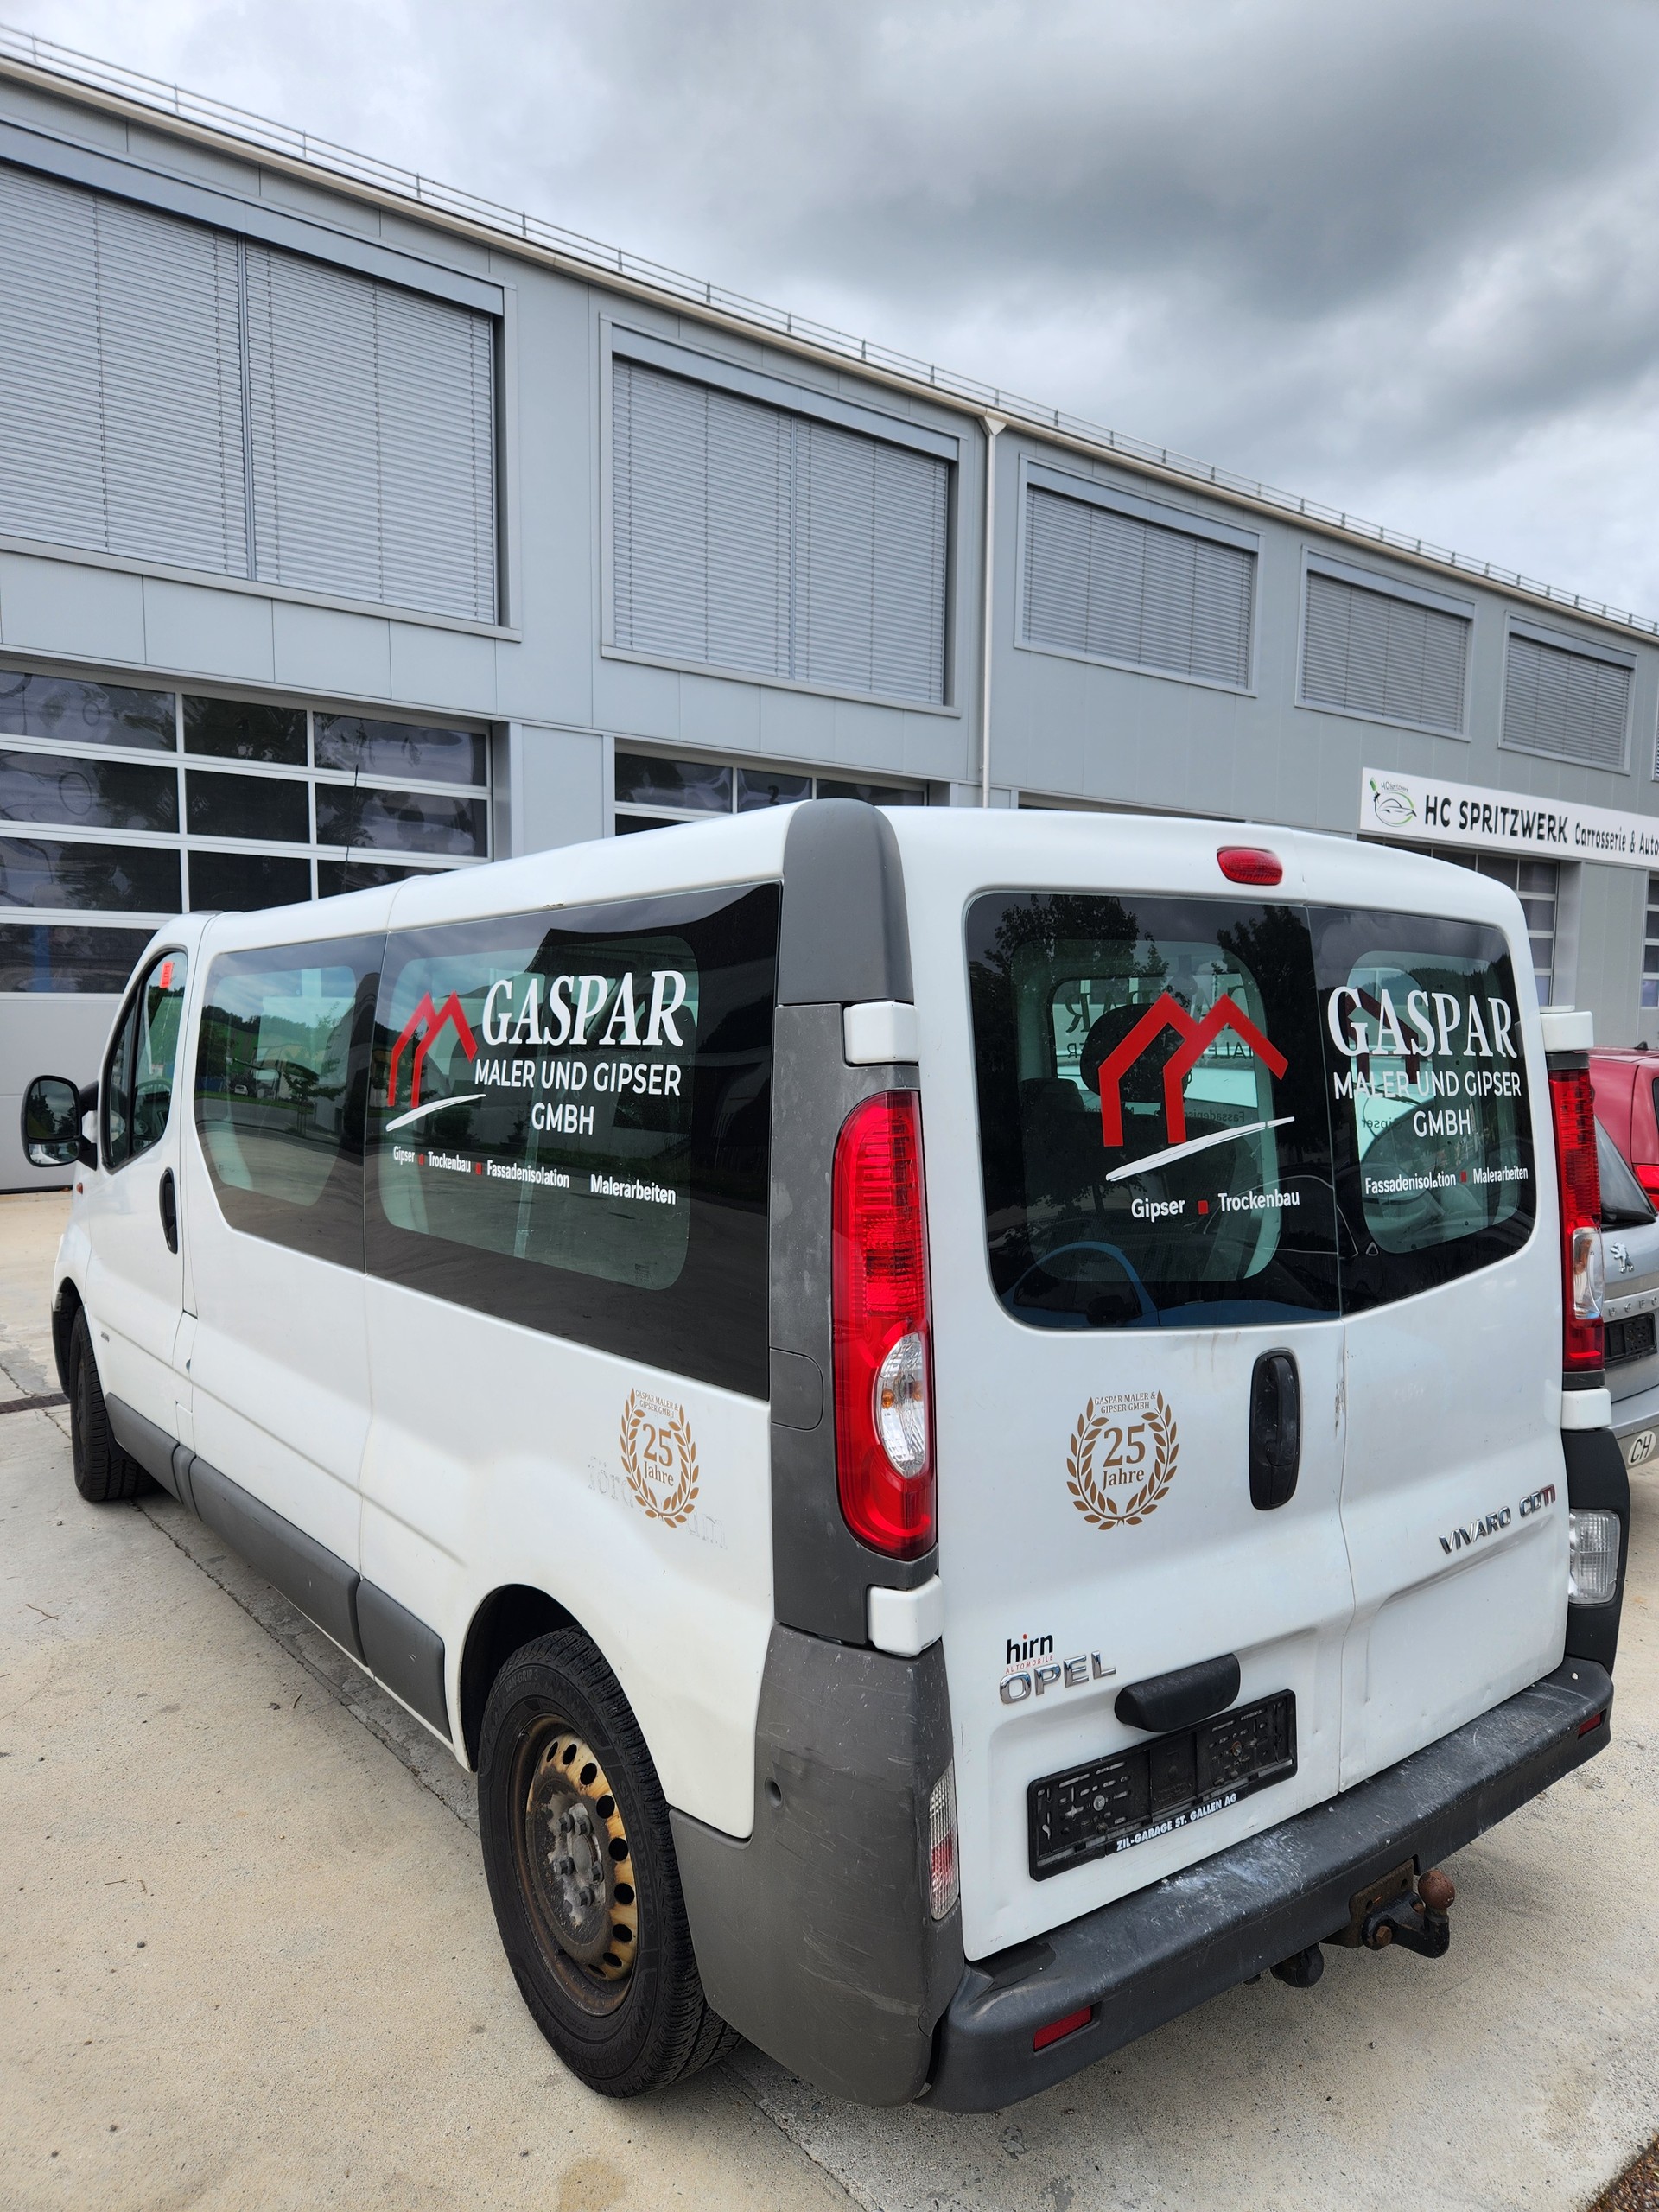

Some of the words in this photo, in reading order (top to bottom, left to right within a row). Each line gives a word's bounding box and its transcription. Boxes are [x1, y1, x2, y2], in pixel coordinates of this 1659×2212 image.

[1425, 794, 1452, 827] HC
[1459, 800, 1568, 843] SPRITZWERK
[1575, 821, 1626, 852] Carrosserie
[1630, 830, 1636, 853] &
[482, 970, 686, 1046] GASPAR
[1327, 986, 1517, 1058] GASPAR
[474, 1058, 535, 1088] MALER
[541, 1061, 588, 1091] UND
[594, 1062, 681, 1096] GIPSER
[1333, 1071, 1409, 1100] MALER
[1417, 1071, 1459, 1096] UND
[1465, 1071, 1522, 1096] GIPSER
[531, 1102, 594, 1135] GMBH
[1413, 1109, 1471, 1137] GMBH
[393, 1145, 415, 1163] Gipser
[429, 1150, 471, 1173] Trockenbau
[486, 1160, 570, 1188] Fassadenisolation
[590, 1174, 677, 1205] Malerarbeiten
[1131, 1196, 1185, 1222] Gipser
[1217, 1189, 1300, 1212] Trockenbau
[1365, 1171, 1457, 1195] Fassadenisolation
[1473, 1166, 1529, 1185] Malerarbeiten
[635, 1389, 655, 1402] GASPAR
[655, 1396, 674, 1409] MALER
[639, 1400, 658, 1412] GIPSER
[658, 1407, 674, 1418] GMBH
[1094, 1395, 1122, 1406] GASPAR
[1124, 1392, 1149, 1402] MALER
[1150, 1391, 1156, 1400] &
[1100, 1403, 1127, 1414] GIPSER
[1128, 1401, 1150, 1411] GMBH
[642, 1423, 673, 1467] 25
[1103, 1423, 1146, 1467] 25
[1630, 1433, 1653, 1463] CH
[644, 1460, 674, 1486] Jahre
[1102, 1468, 1145, 1491] Jahre
[1439, 1506, 1511, 1554] VIVARO
[1519, 1484, 1556, 1518] CDTI
[1005, 1654, 1053, 1675] AUTOMOBILE
[1006, 1633, 1053, 1665] hirn
[999, 1650, 1116, 1705] OPEL
[1116, 1821, 1173, 1851] ZIL-GARAGE
[1174, 1815, 1187, 1827] ST.
[1189, 1799, 1223, 1821] GALLEN
[1224, 1793, 1237, 1807] AG
